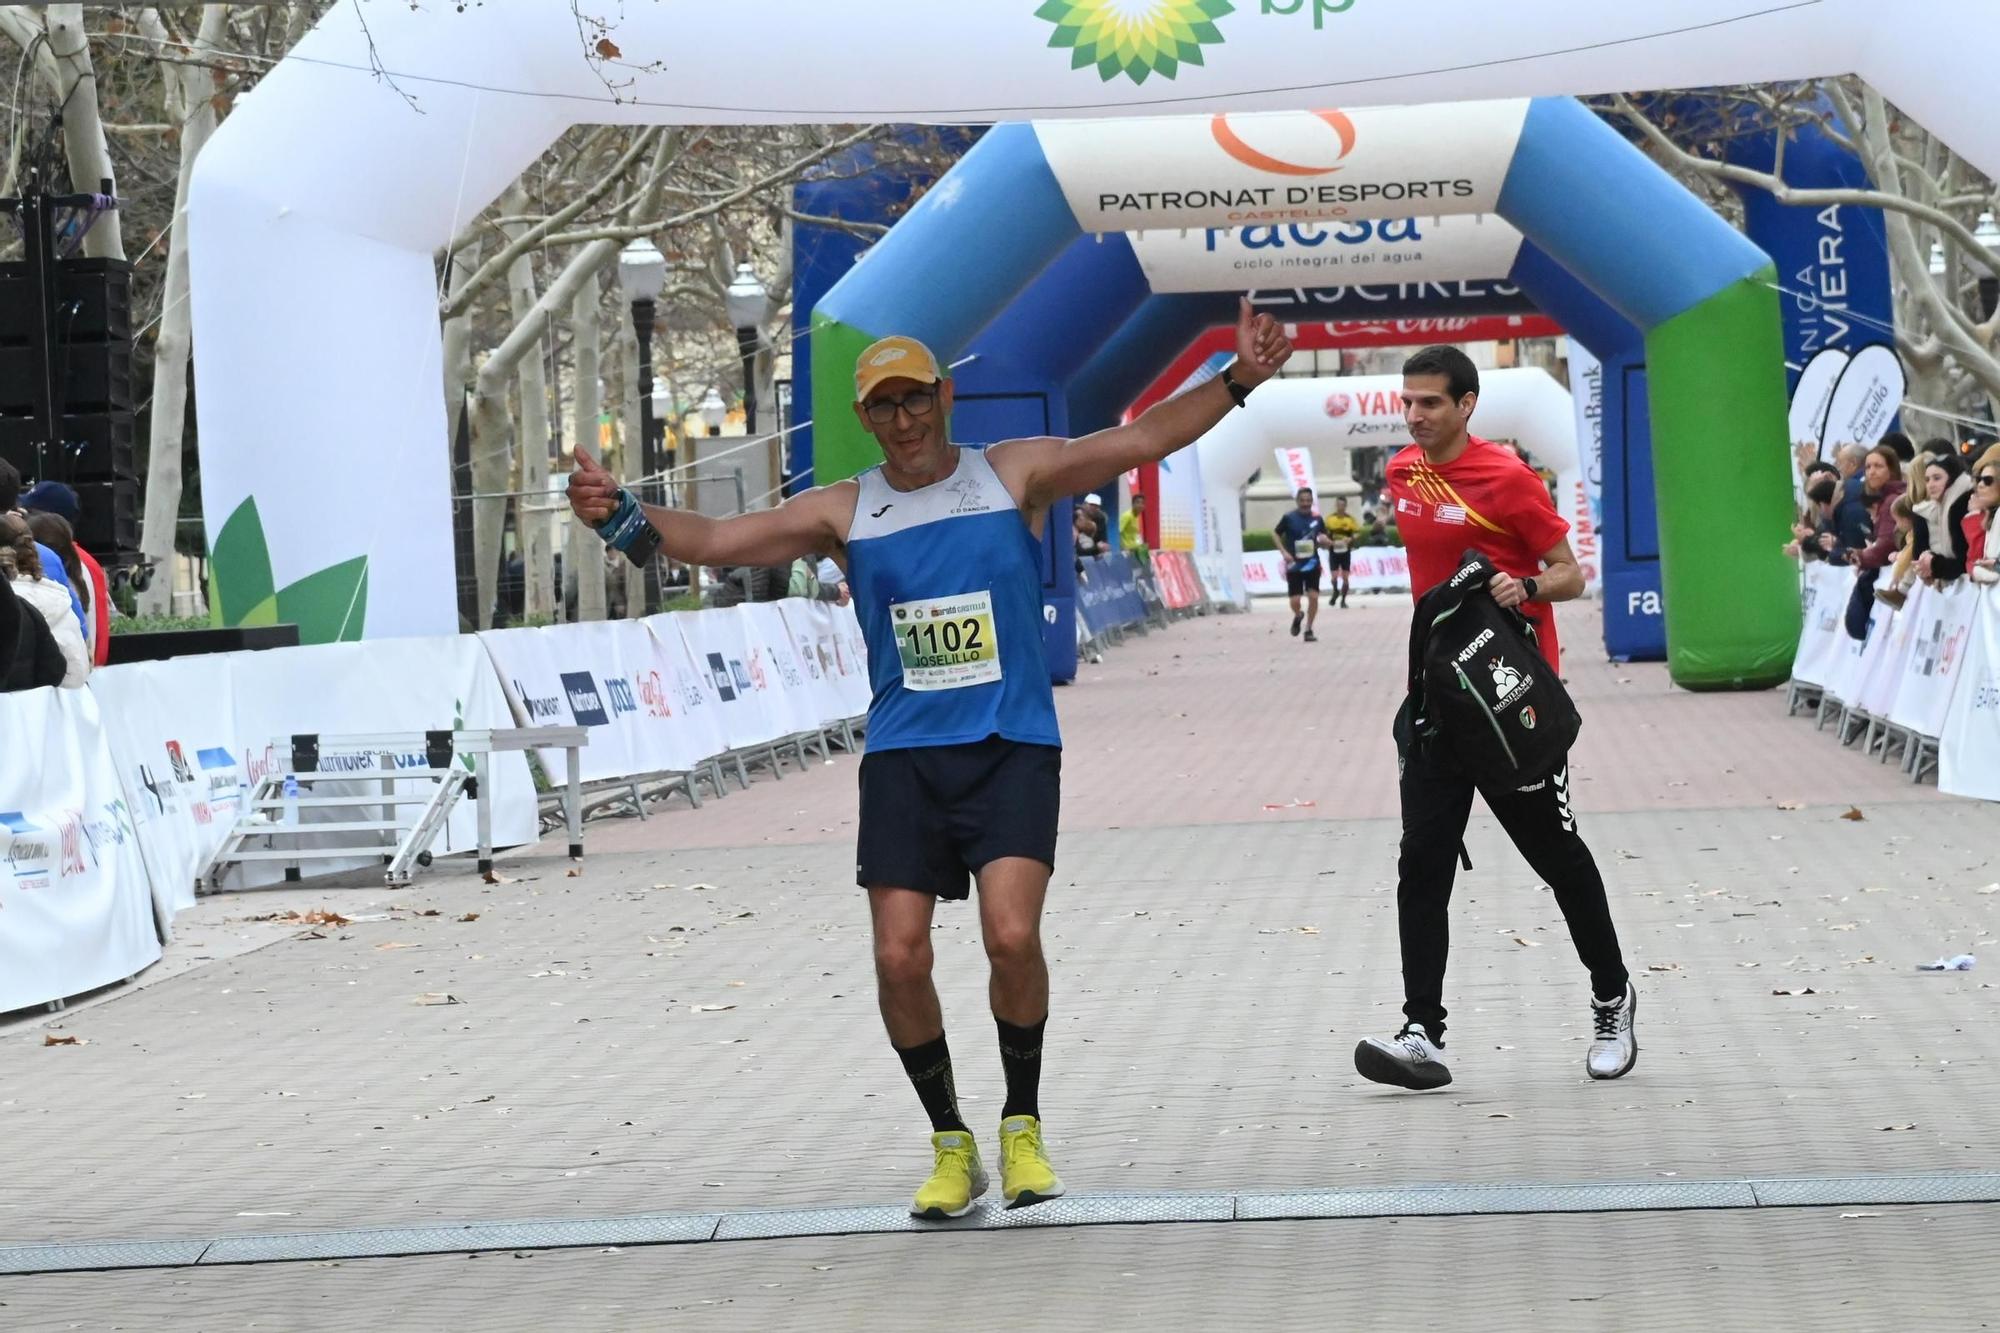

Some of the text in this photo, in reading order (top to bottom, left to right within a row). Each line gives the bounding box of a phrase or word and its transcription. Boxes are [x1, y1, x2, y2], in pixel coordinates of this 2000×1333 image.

[1100, 178, 1474, 212] PATRONAT D'ESPORTS
[1233, 251, 1423, 270] ciclo integral del agua
[907, 618, 983, 656] 1102
[914, 650, 980, 668] JOSELILLO
